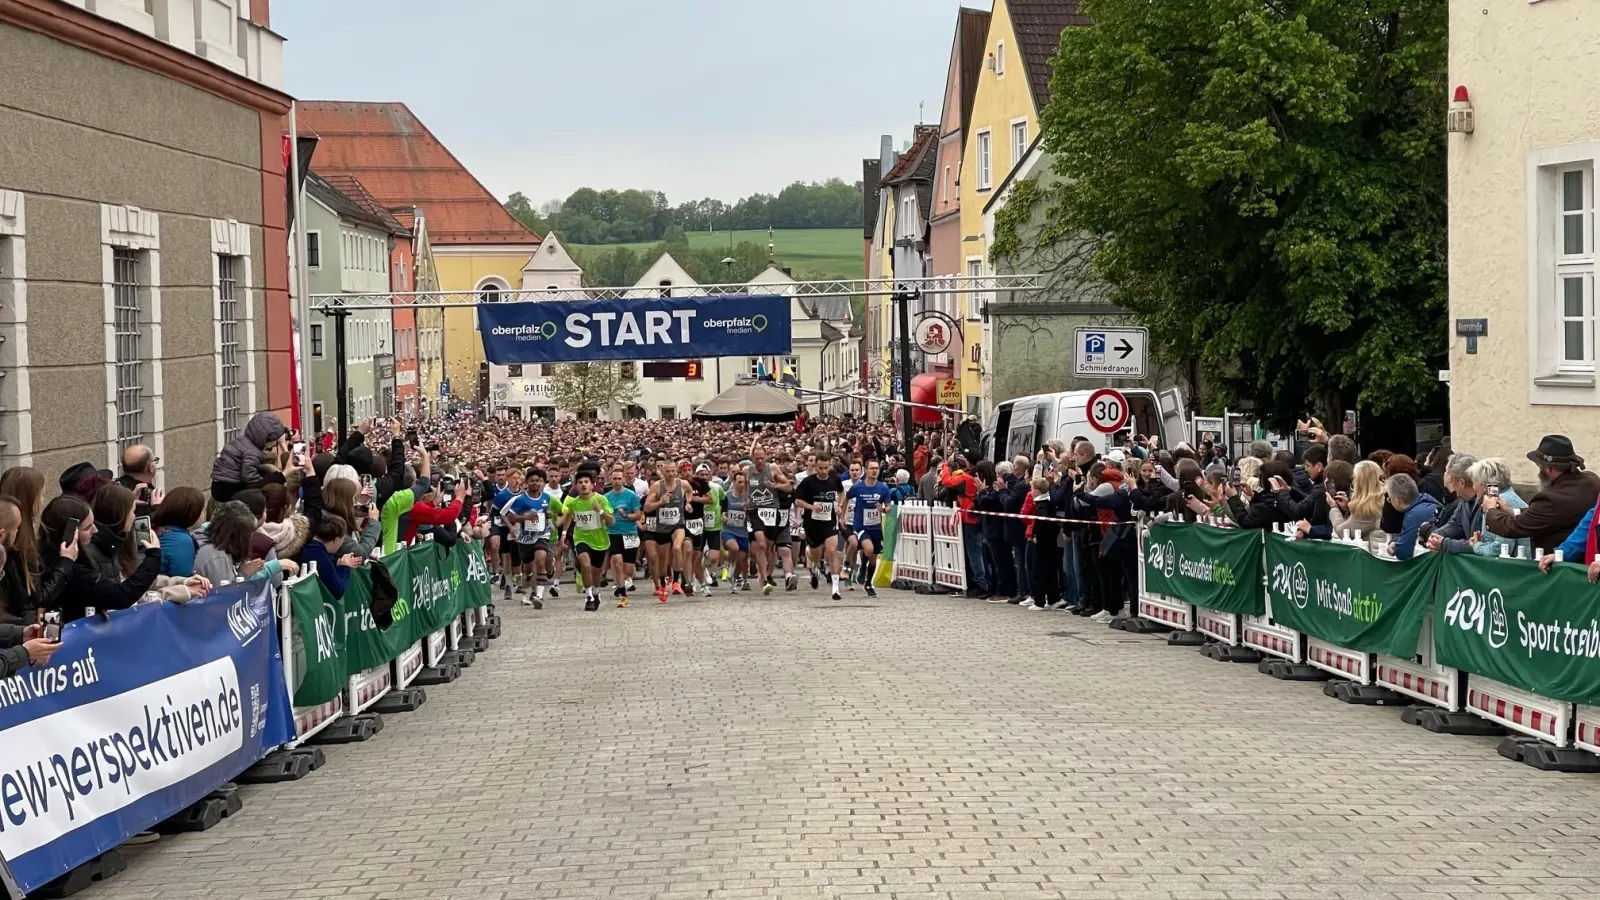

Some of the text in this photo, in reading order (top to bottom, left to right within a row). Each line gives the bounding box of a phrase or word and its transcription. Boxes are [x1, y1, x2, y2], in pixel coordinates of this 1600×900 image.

[491, 325, 541, 336] oberpfalz
[564, 309, 697, 348] START
[703, 317, 752, 328] oberpfalz
[688, 363, 697, 376] 3
[1080, 364, 1139, 373] Schmiedrangen
[1095, 401, 1119, 421] 30
[576, 513, 593, 522] 1987
[1316, 578, 1333, 609] Mit
[1332, 582, 1352, 620] Spaß
[1352, 592, 1383, 623] aktiv
[1444, 587, 1600, 658] AOK Sport treib
[0, 647, 100, 708] nen uns auf
[0, 677, 240, 832] ew-perspektiven.de
